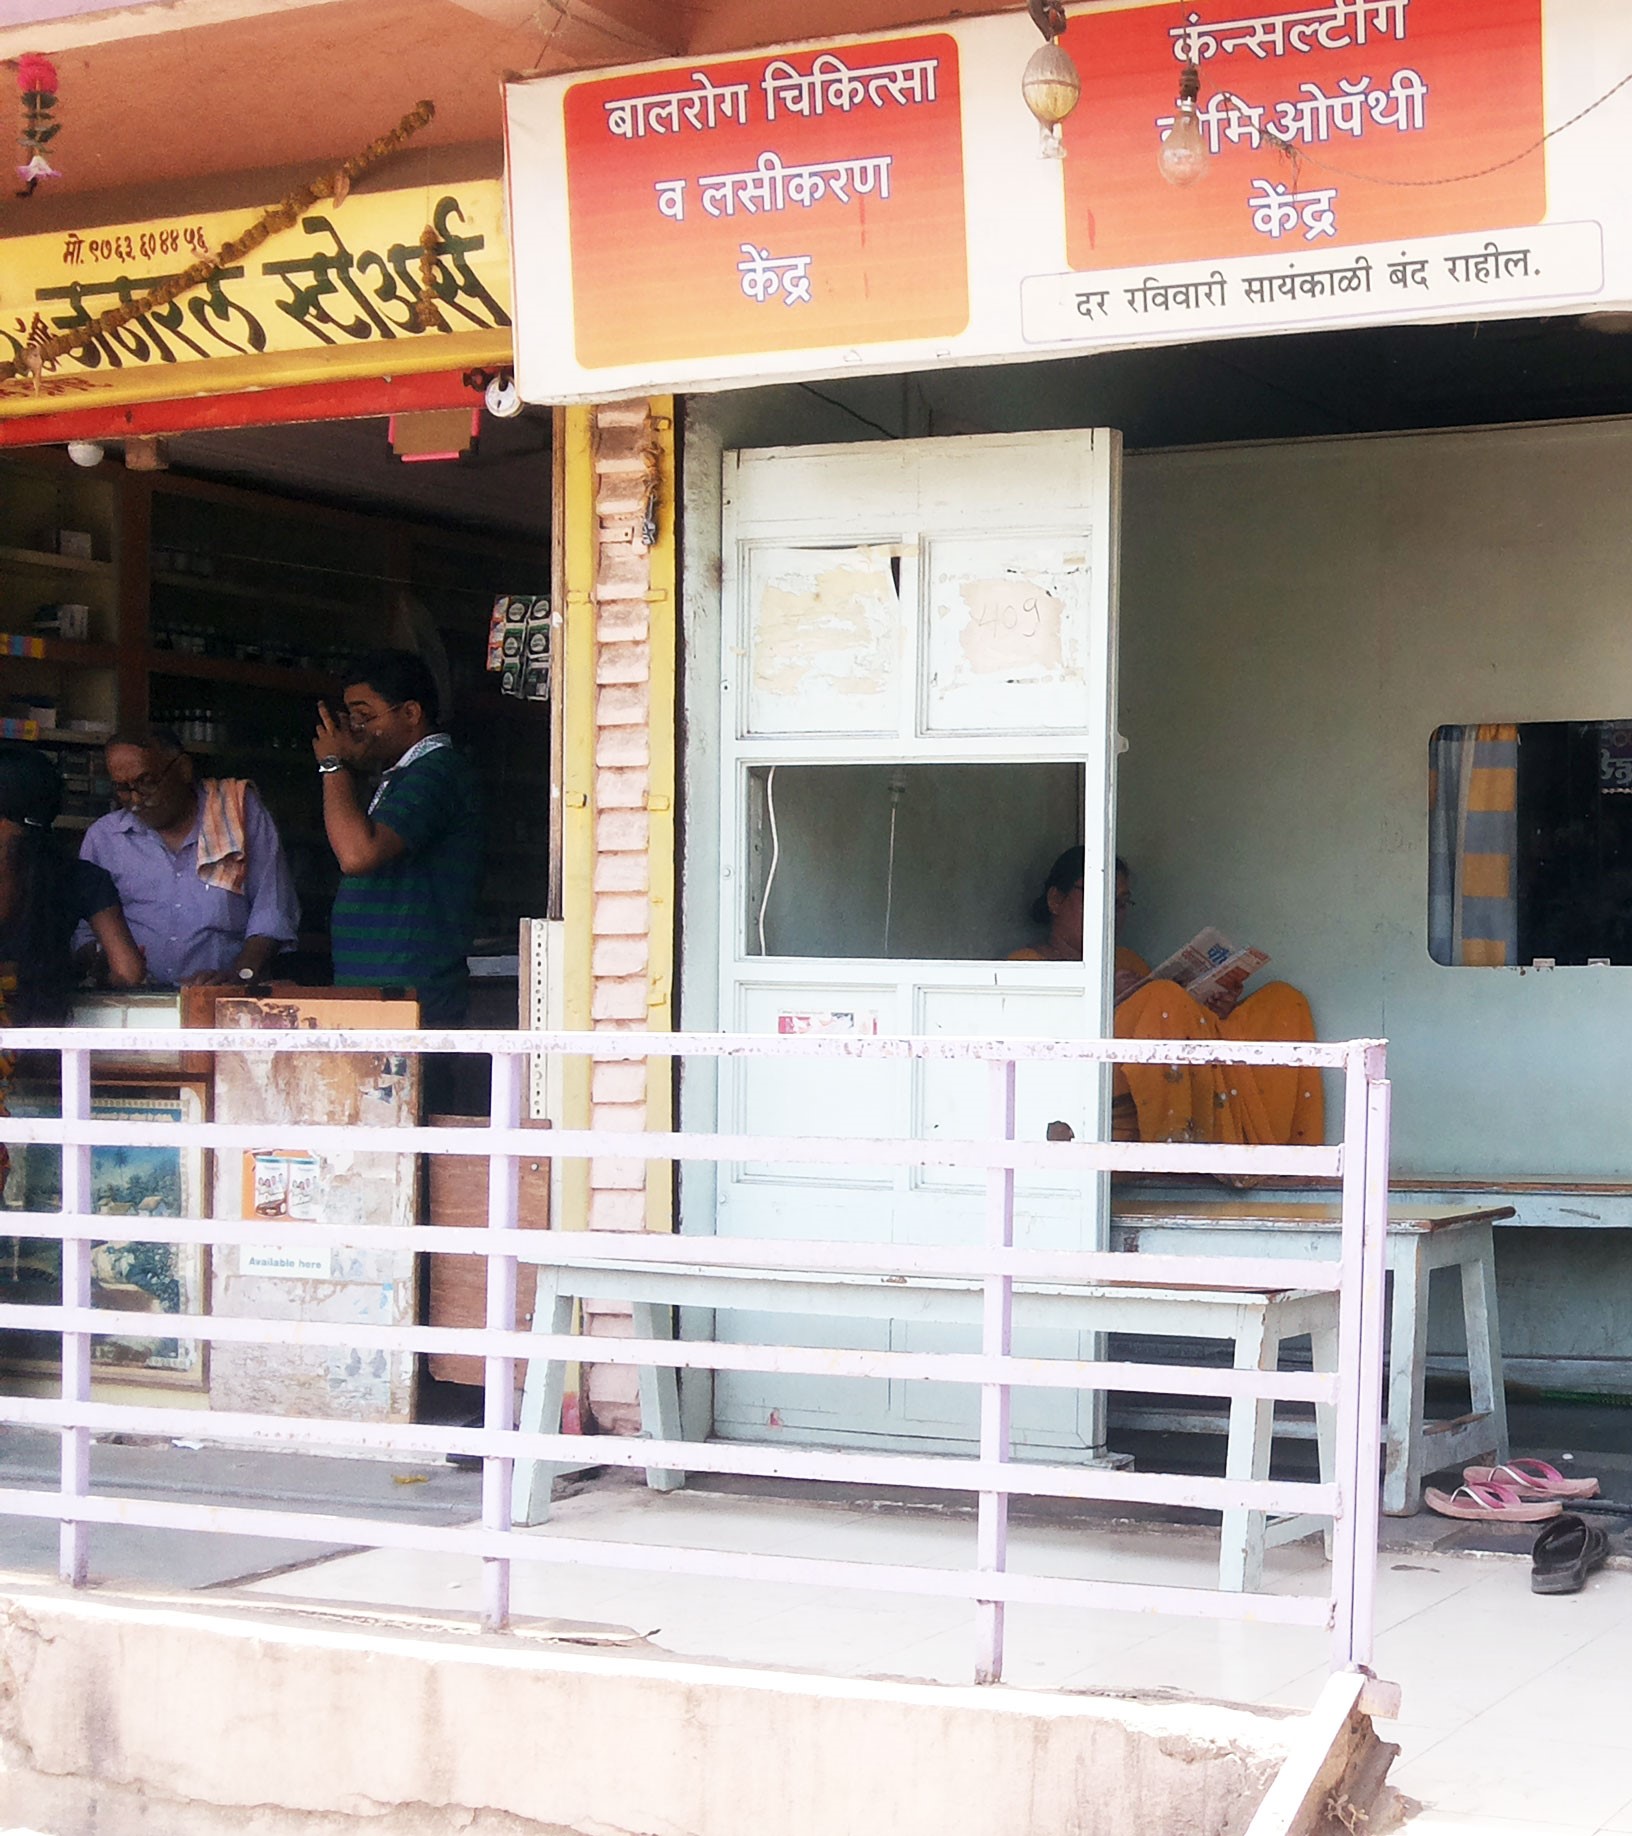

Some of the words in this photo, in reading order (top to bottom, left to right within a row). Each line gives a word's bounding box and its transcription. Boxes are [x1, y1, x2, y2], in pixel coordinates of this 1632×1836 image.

[604, 73, 748, 139] बालरोग
[762, 54, 938, 121] चिकित्सा
[655, 179, 686, 220] व
[700, 151, 892, 217] लसीकरण
[1249, 179, 1337, 240] केंद्र
[738, 243, 811, 305] केंद्र
[1076, 289, 1109, 320] दर
[1125, 272, 1227, 314] रविवारी
[1243, 255, 1372, 303] सायंकाळी
[1388, 248, 1429, 289] बंद
[1445, 242, 1540, 284] राहील.
[249, 1257, 295, 1268] Available
[299, 1258, 322, 1269] here
